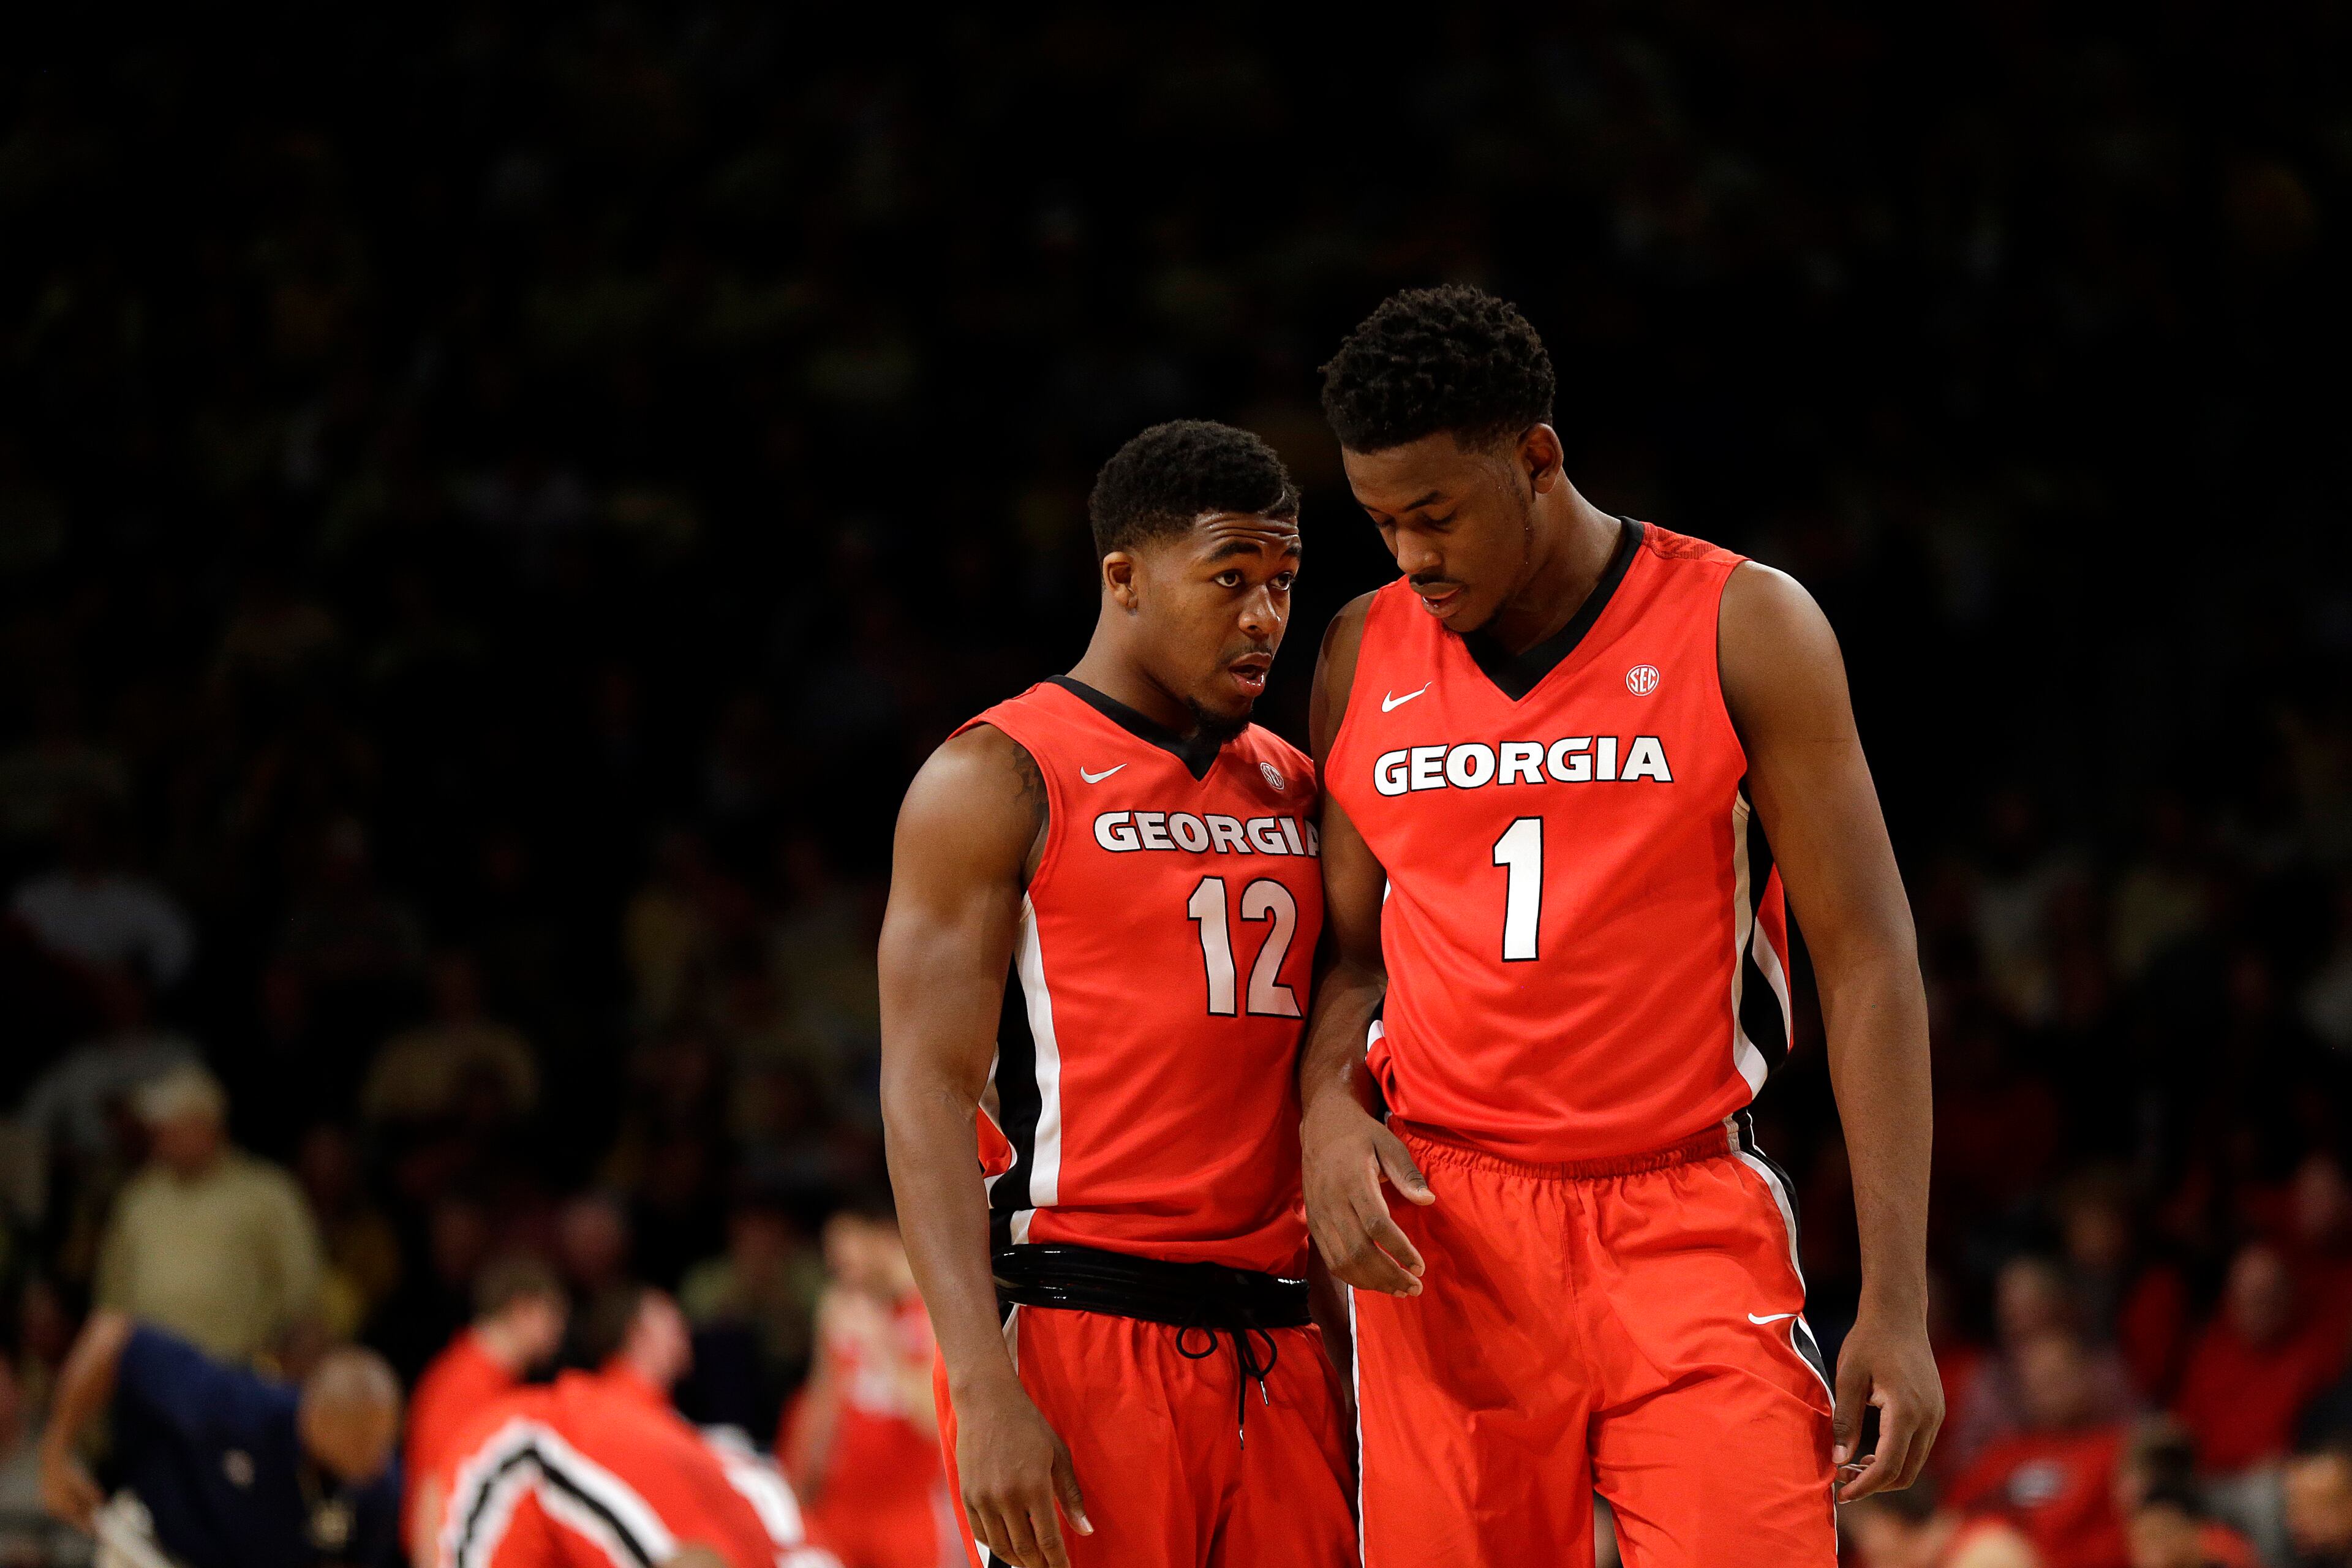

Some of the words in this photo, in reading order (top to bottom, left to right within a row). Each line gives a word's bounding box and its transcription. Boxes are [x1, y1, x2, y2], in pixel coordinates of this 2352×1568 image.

[1629, 667, 1656, 692] SEC
[1262, 764, 1283, 787] SEC
[1373, 736, 1674, 796] GEORGIA
[1492, 816, 1544, 962] 1
[1187, 876, 1303, 1019] 12
